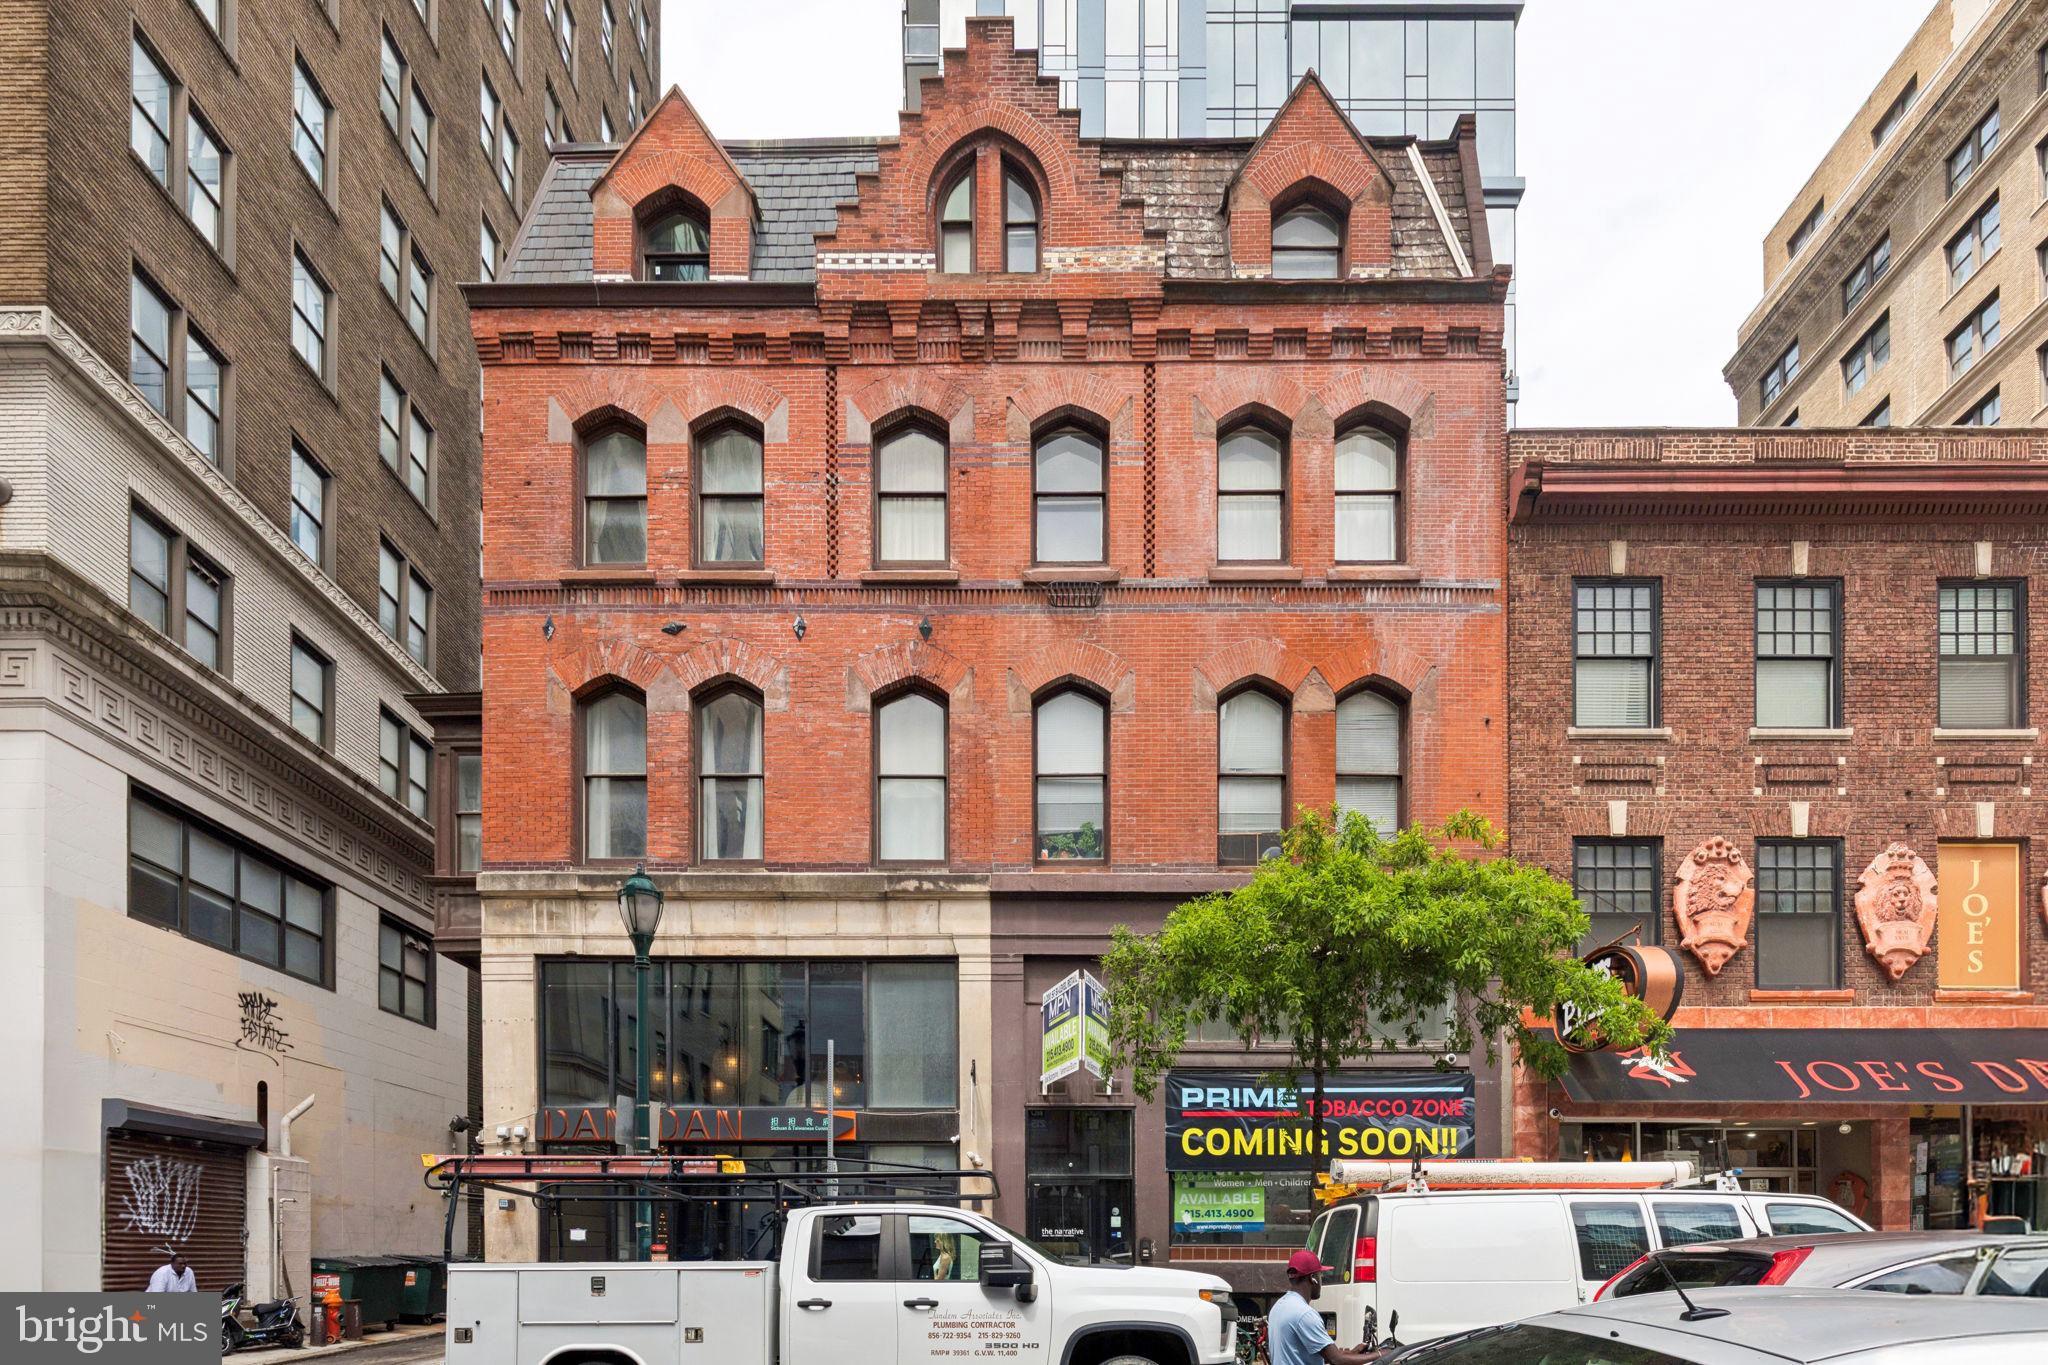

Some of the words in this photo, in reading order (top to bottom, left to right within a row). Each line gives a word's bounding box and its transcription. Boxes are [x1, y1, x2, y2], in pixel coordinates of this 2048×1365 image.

[1962, 859, 1992, 973] JOE'S
[1048, 988, 1072, 1020] MPN
[1774, 1060, 1964, 1098] JOE'S
[1181, 1087, 1298, 1108] PRIME
[1305, 1099, 1408, 1117] TOBACCO
[1411, 1099, 1465, 1117] ZONE
[659, 1108, 742, 1140] DAN
[1181, 1127, 1329, 1156] COMING
[1338, 1127, 1458, 1156] SOON!!
[1214, 1179, 1245, 1188] Women
[1255, 1179, 1273, 1188] Men
[1179, 1193, 1260, 1205] AVAILABLE
[1041, 1227, 1053, 1235] the
[1054, 1227, 1084, 1235] narrative
[960, 1308, 1003, 1320] Associates
[932, 1321, 968, 1329] PLUMBING
[970, 1321, 1016, 1329] CONTRACTOR
[930, 1349, 950, 1357] RMP#
[974, 1349, 996, 1357] G.V.W.
[997, 1349, 1018, 1357] 11,400
